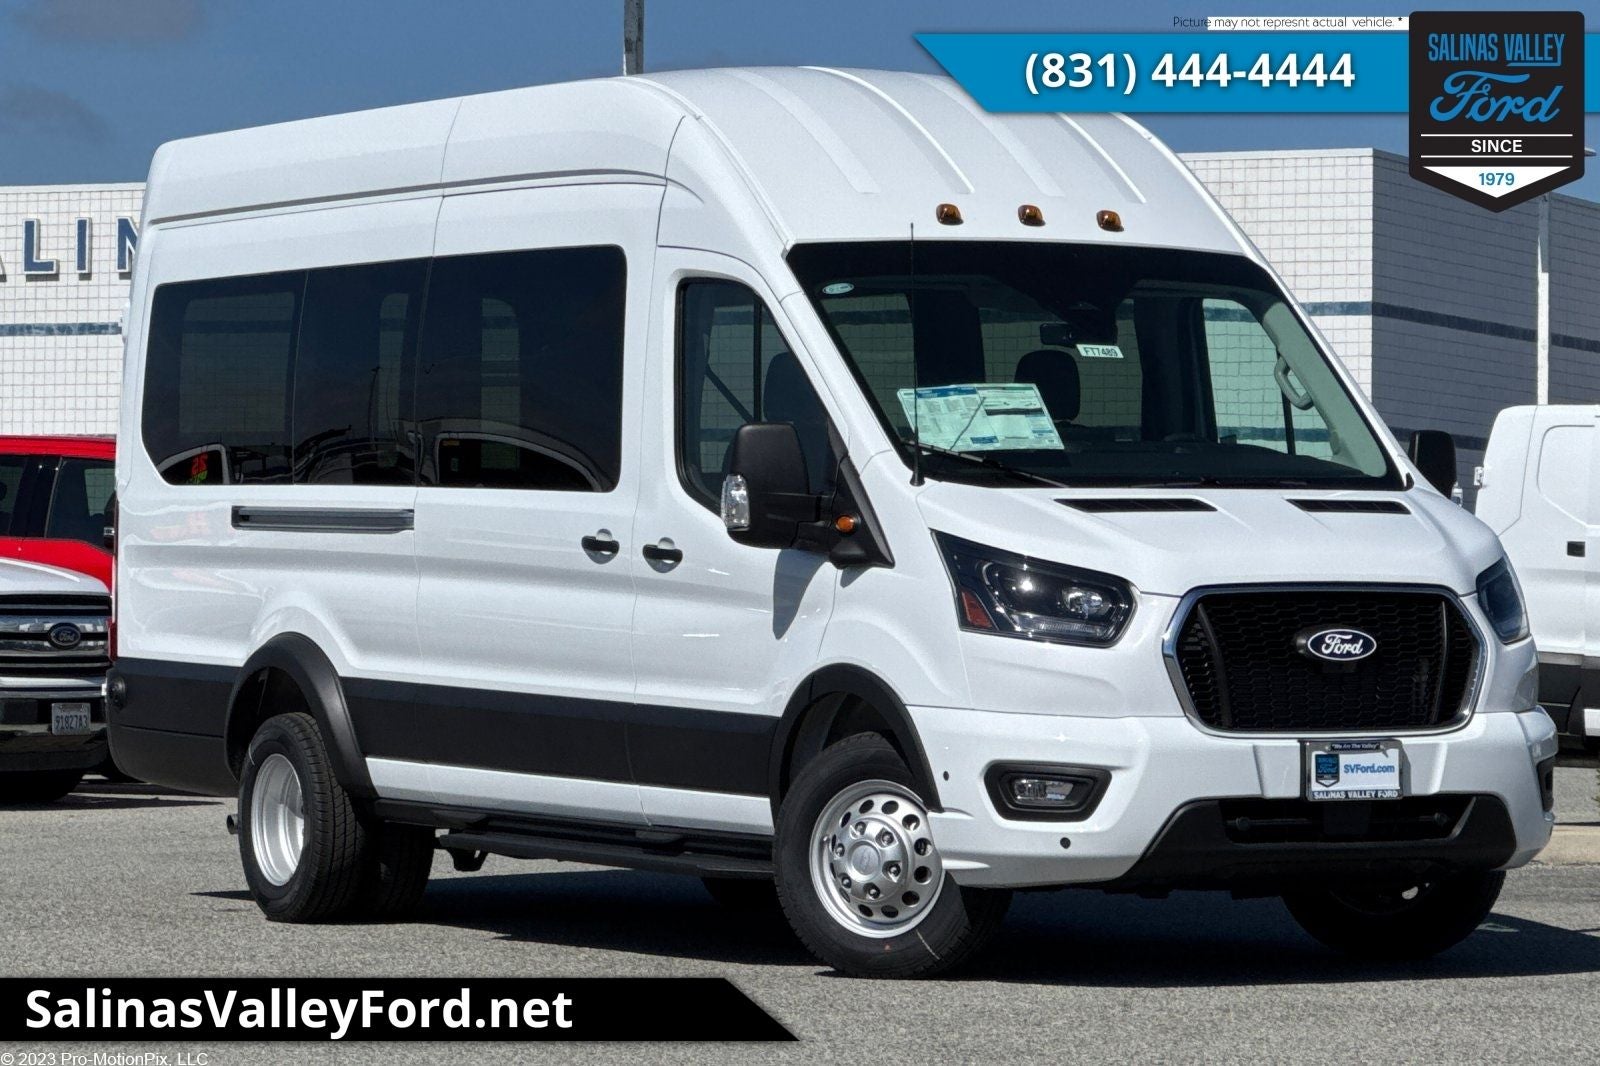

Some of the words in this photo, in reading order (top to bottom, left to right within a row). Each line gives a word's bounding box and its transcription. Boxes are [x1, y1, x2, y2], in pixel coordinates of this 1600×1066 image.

[0, 216, 138, 277] LIN
[1321, 633, 1364, 655] Ford
[1343, 763, 1396, 774] SVFord.com
[1313, 790, 1346, 800] SALINAS
[1347, 790, 1376, 799] VALLEY
[1377, 790, 1399, 799] FORD
